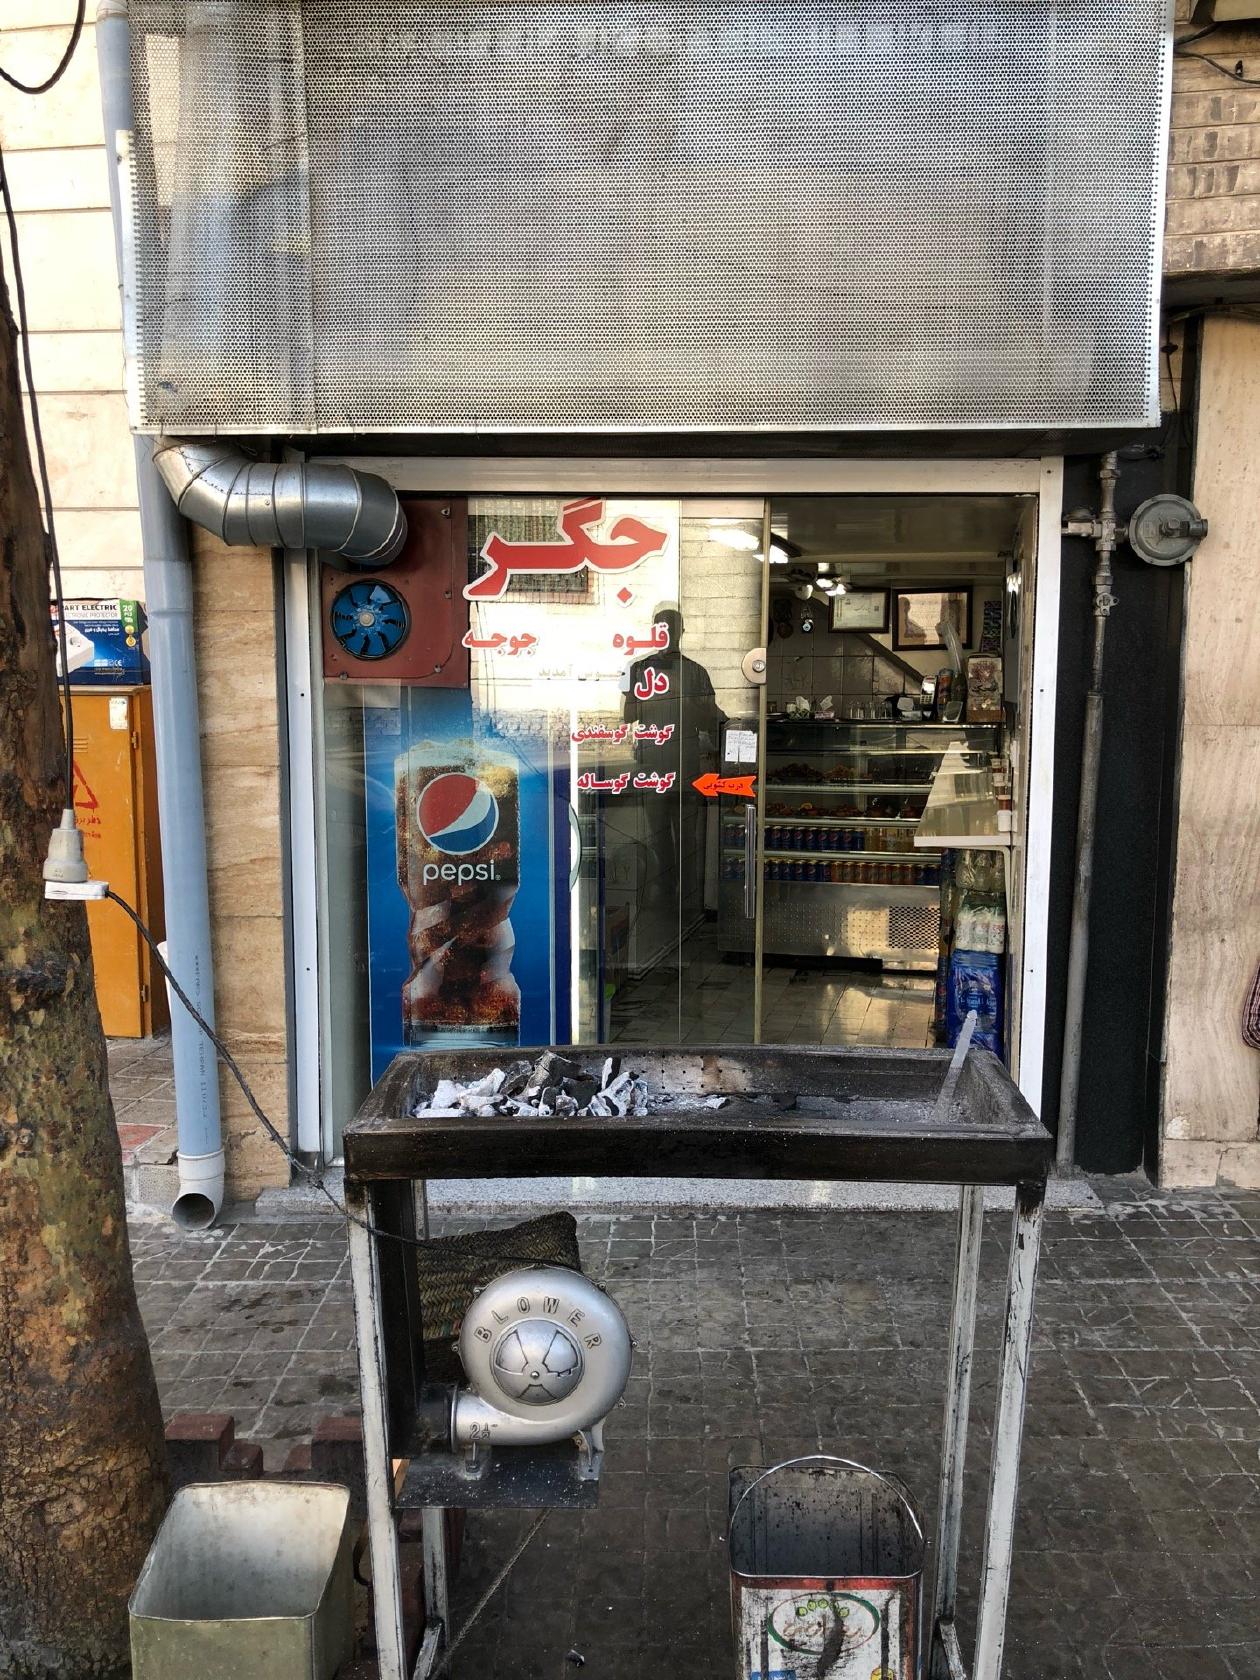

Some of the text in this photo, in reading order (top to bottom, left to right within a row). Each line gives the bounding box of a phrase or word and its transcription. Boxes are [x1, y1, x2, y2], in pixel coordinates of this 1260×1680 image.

[464, 497, 668, 606] جگر
[462, 622, 669, 656] قلوه جوجه
[635, 667, 669, 700] دل
[571, 723, 675, 744] گوشت گوسفندی
[577, 772, 676, 794] گوشت گوساله
[728, 782, 744, 791] درب
[423, 859, 495, 886] pepsi
[474, 1296, 602, 1350] BLOWER
